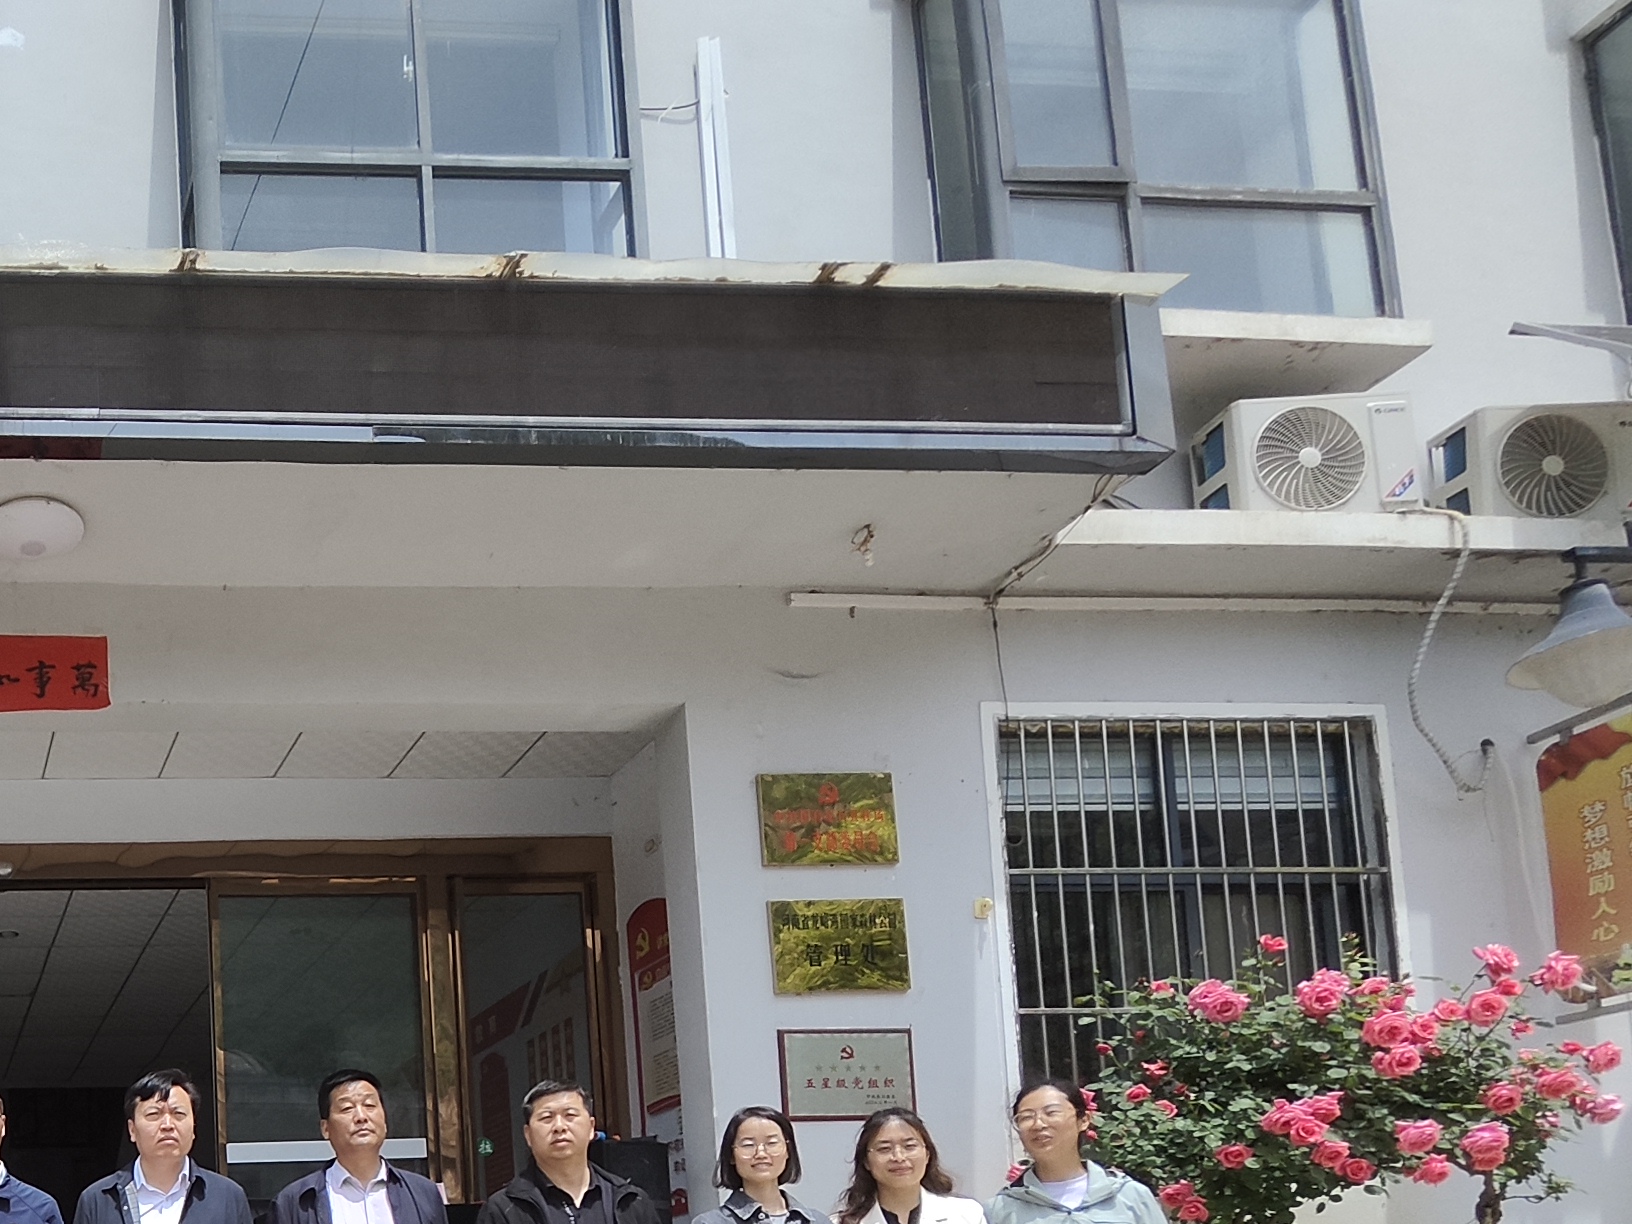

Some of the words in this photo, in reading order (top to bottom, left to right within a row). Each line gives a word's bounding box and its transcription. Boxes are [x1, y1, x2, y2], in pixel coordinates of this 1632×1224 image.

[1579, 800, 1619, 942] 梦想激励人心
[804, 1077, 895, 1090] 五星级党组织
